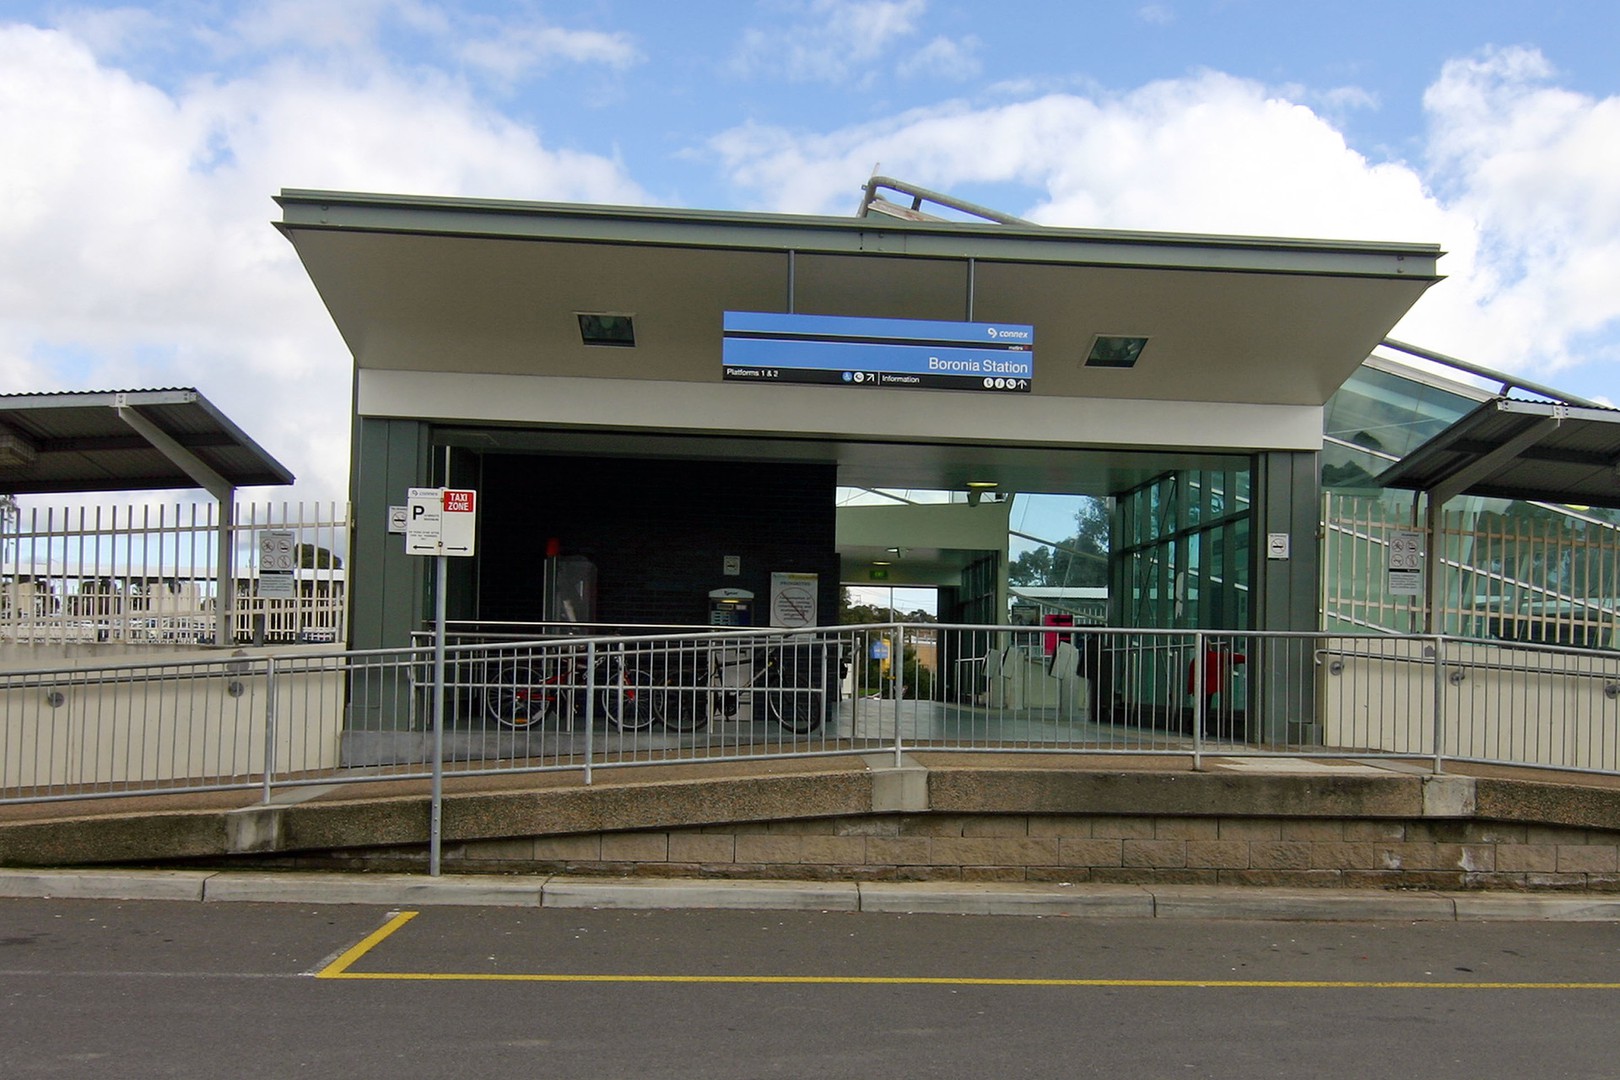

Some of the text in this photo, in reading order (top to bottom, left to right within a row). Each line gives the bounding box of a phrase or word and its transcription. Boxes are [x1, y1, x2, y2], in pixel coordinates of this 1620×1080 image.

[929, 357, 1028, 373] Boronia Station
[726, 368, 760, 377] Platforms
[882, 375, 920, 383] Information
[450, 493, 468, 502] TAXI
[448, 502, 469, 511] ZONE
[413, 505, 425, 520] P
